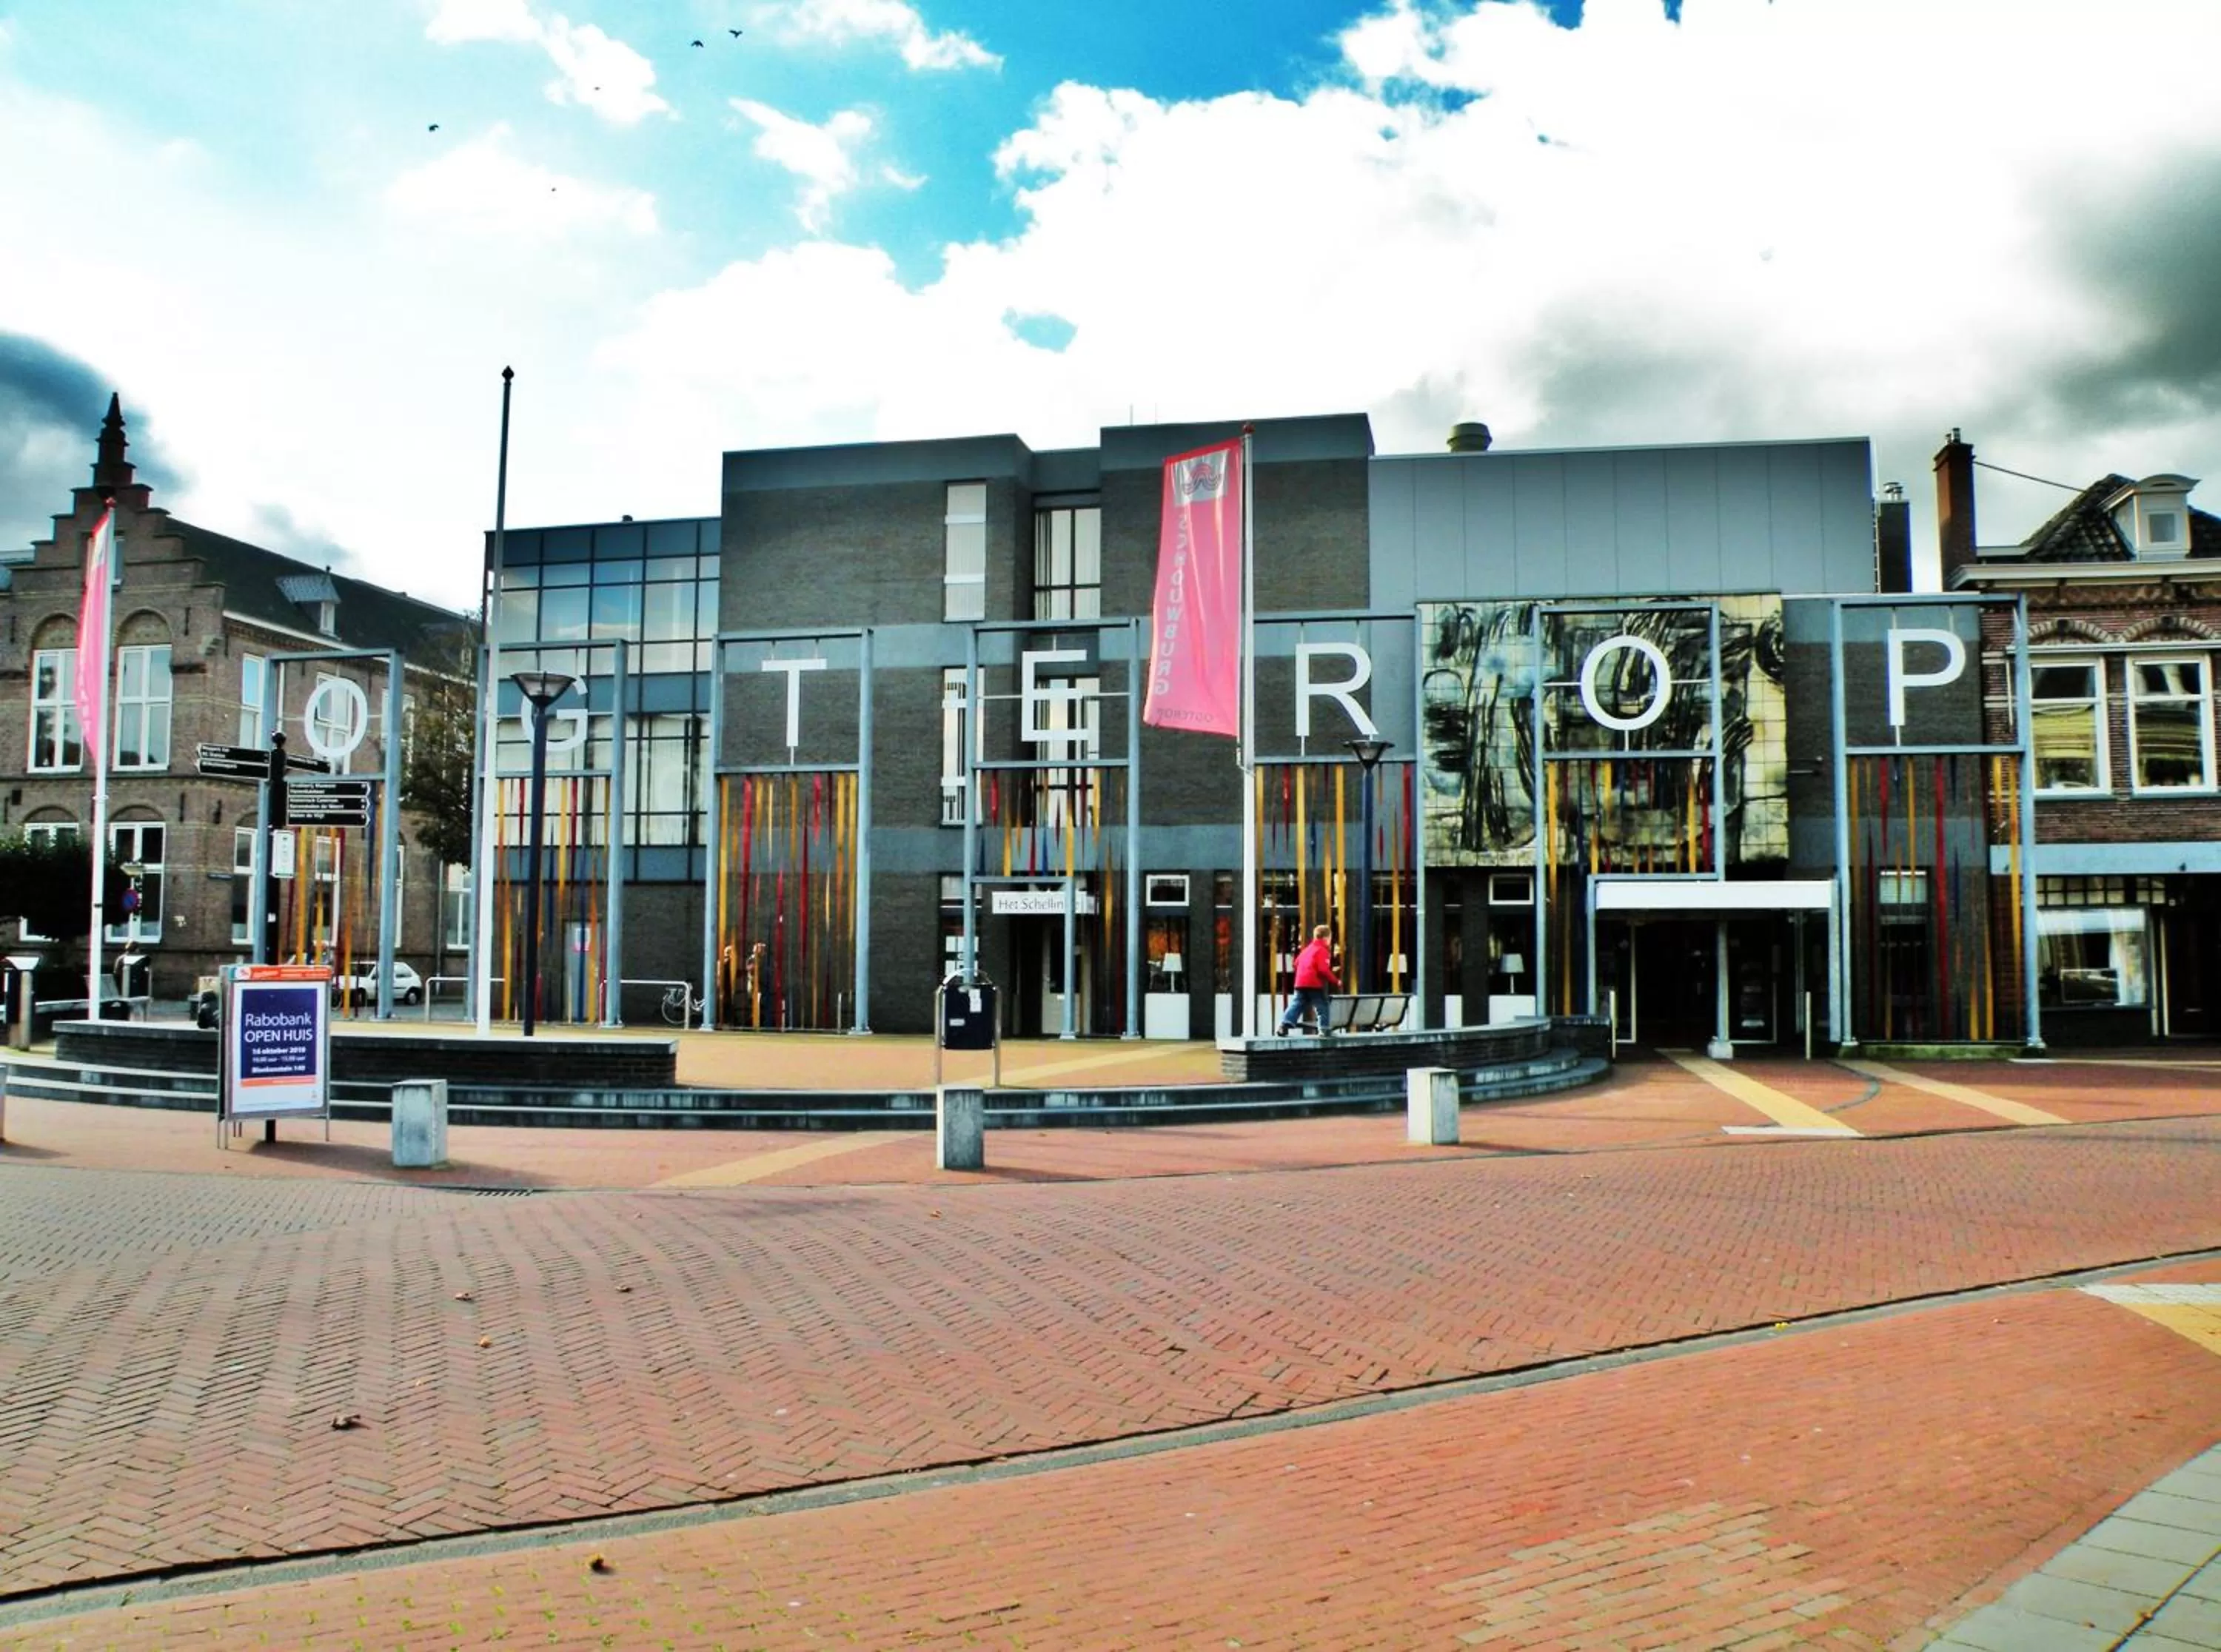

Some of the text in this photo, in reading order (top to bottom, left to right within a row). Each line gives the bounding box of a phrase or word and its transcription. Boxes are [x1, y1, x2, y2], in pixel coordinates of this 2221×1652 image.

[999, 899, 1018, 910] Het
[245, 1012, 312, 1027] Rabobank
[244, 1028, 313, 1043] OPEN HUIS
